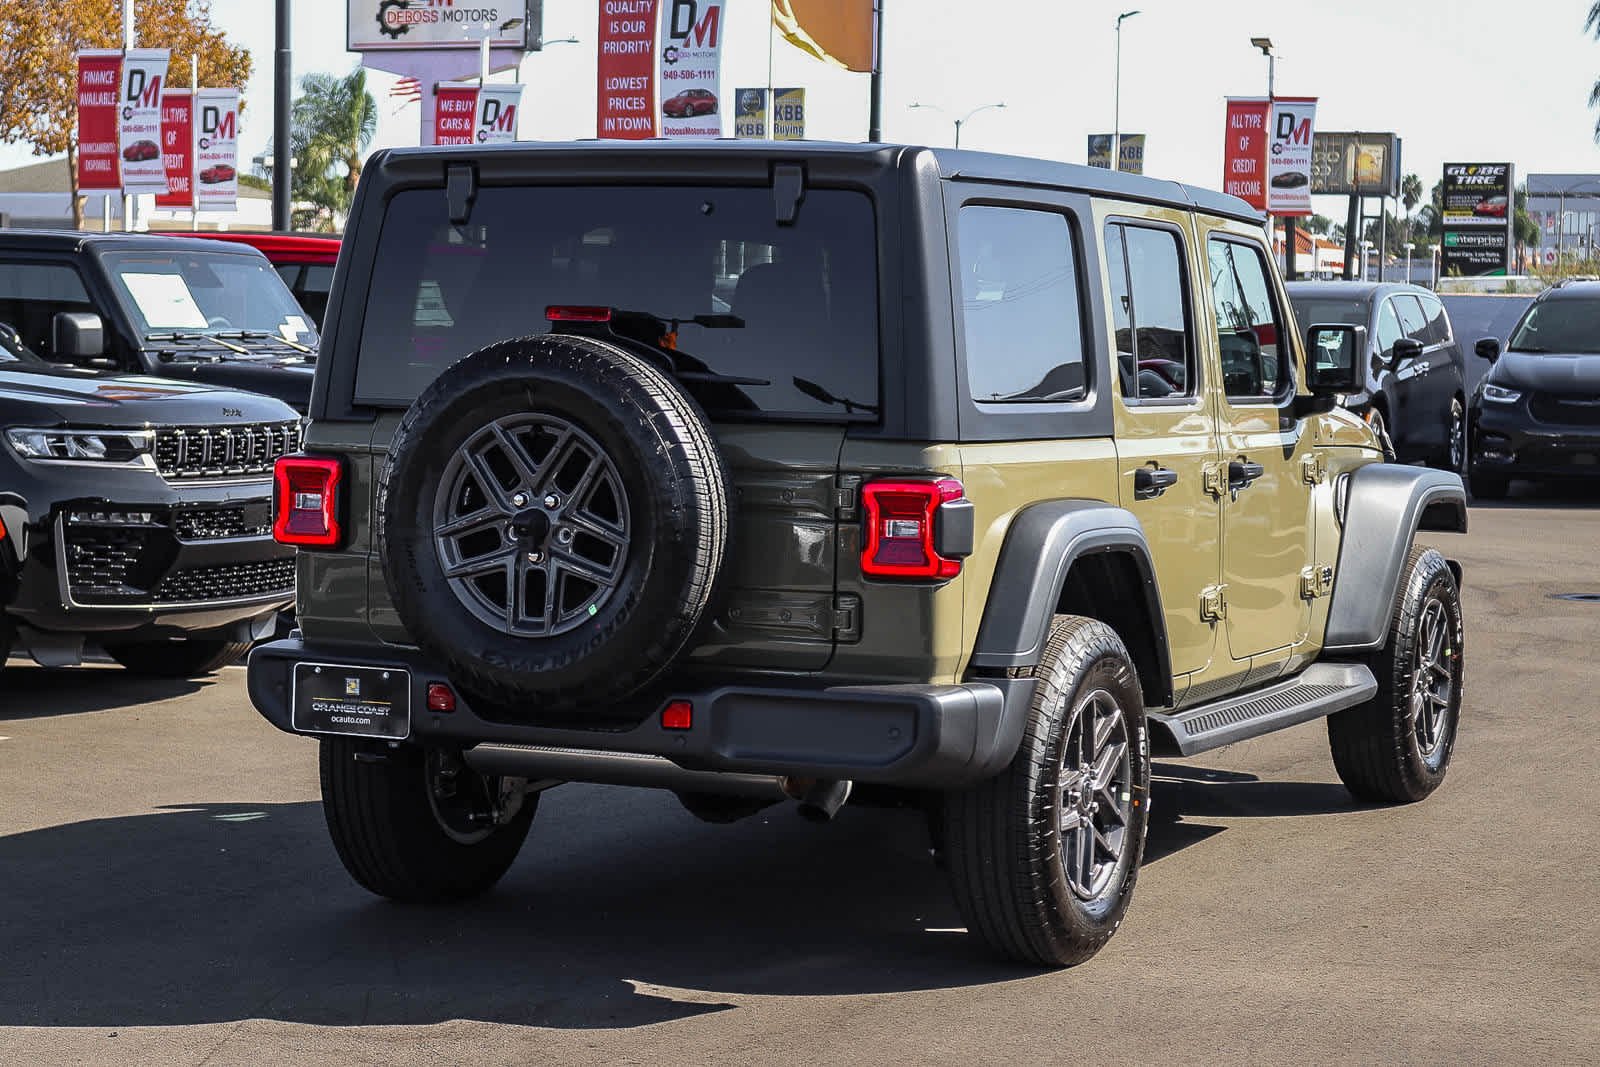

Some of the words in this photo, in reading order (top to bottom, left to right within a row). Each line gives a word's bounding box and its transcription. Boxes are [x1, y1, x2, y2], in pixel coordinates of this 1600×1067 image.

[606, 1, 653, 14] QUALITY
[387, 10, 439, 24] DEBOSS
[443, 9, 498, 22] MOTORS
[610, 21, 619, 34] IS
[622, 21, 646, 33] OUR
[603, 41, 652, 54] PRIORITY
[83, 71, 114, 84] FINANCE
[664, 70, 715, 80] 949-506-1111
[128, 69, 161, 108] DM
[607, 77, 648, 90] LOWEST
[80, 93, 116, 106] AVAILABLE
[440, 100, 454, 112] WE
[456, 100, 474, 112] BUY
[609, 97, 646, 111] PRICES
[162, 107, 171, 122] LL
[171, 107, 188, 122] TYPE
[482, 99, 516, 132] DM
[774, 104, 803, 120] KBB
[203, 106, 235, 139] DM
[440, 118, 462, 130] CARS
[464, 118, 471, 130] &
[604, 118, 615, 130] IN
[618, 117, 652, 131] TOWN
[1231, 114, 1243, 128] ALL
[1245, 114, 1262, 128] TYPE
[737, 124, 764, 136] KBB
[774, 124, 804, 137] Buying
[1277, 112, 1311, 145] DM
[167, 130, 177, 145] OF
[1240, 136, 1249, 151] OF
[1120, 147, 1143, 160] KBB
[1231, 158, 1256, 173] CREDIT
[1457, 176, 1496, 184] TIRE
[1227, 181, 1261, 196] WELCOME
[1447, 235, 1504, 246] enterprise
[357, 706, 391, 716] COAST
[331, 715, 371, 725] ocauto.com
